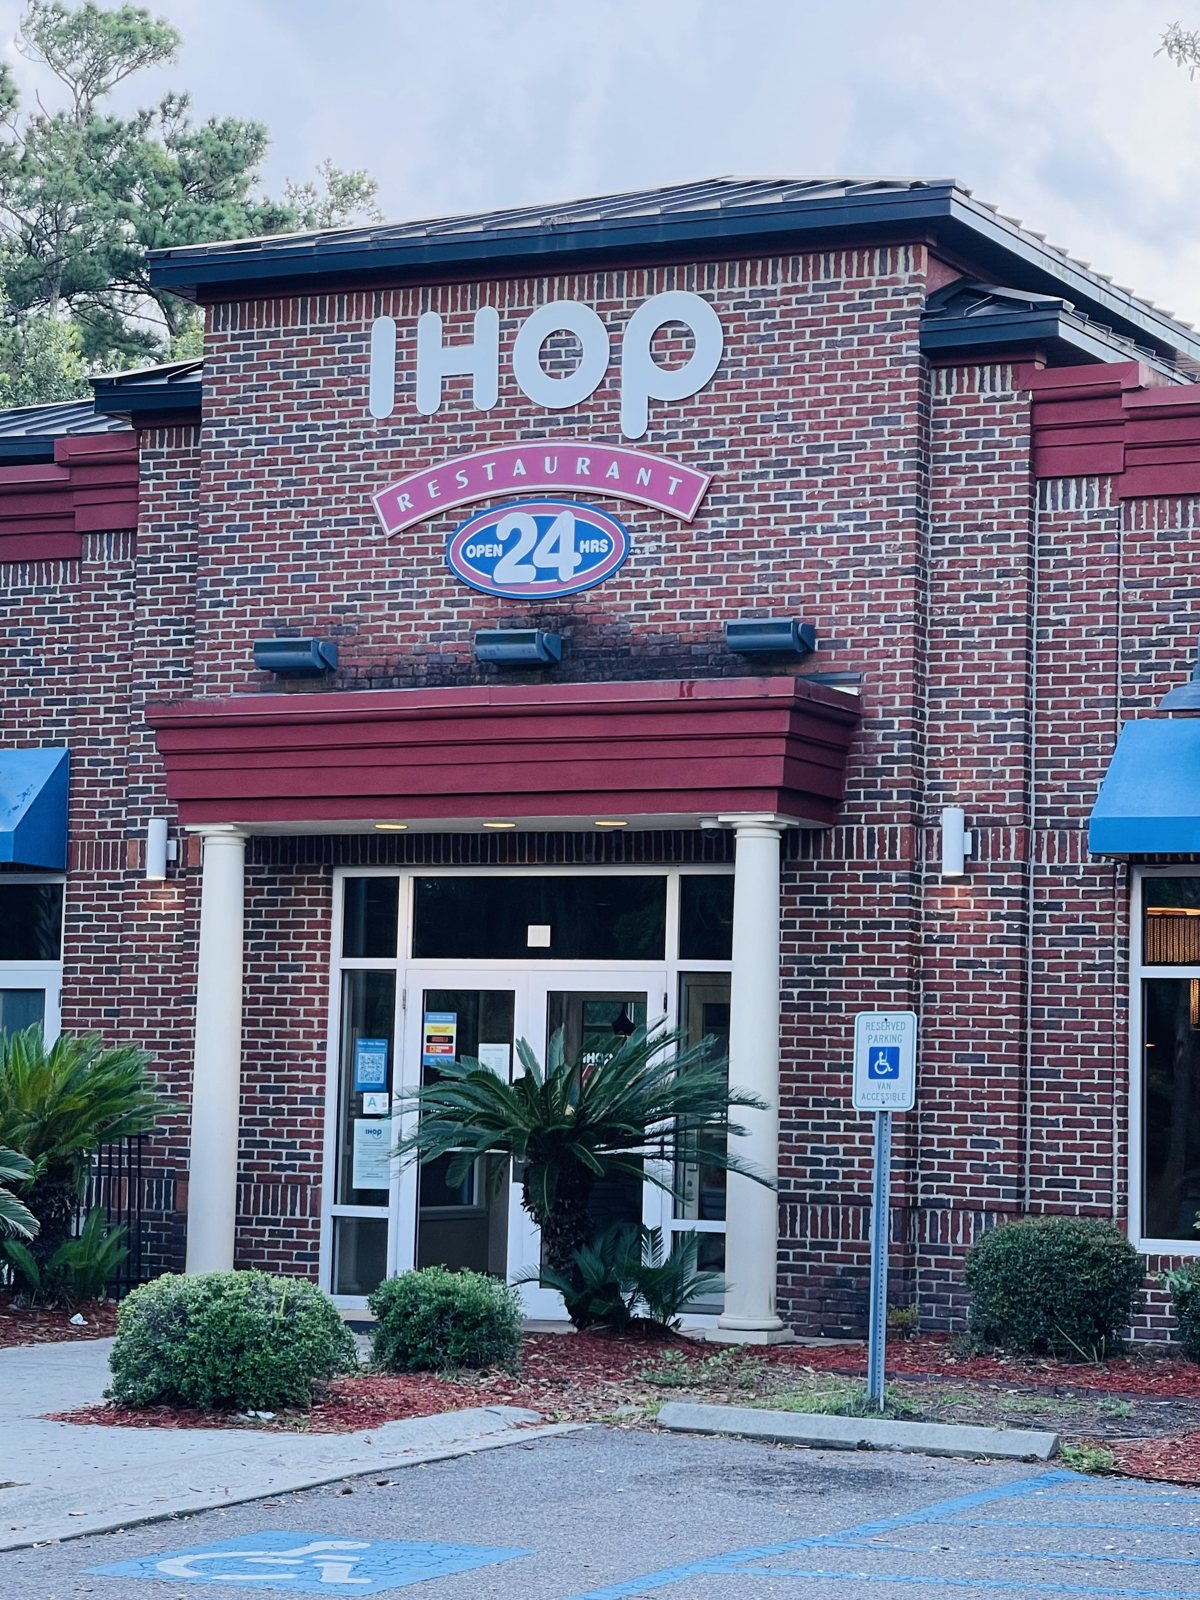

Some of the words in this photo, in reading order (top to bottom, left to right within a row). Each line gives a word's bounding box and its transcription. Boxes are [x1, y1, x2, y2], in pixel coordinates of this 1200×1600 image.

[397, 455, 683, 513] RESTAURANT
[466, 543, 503, 559] OPEN
[493, 510, 582, 585] 24
[579, 539, 609, 554] HRS
[865, 1021, 906, 1031] RESERVED
[868, 1034, 903, 1044] PARKING
[877, 1082, 891, 1090] VAN
[861, 1092, 906, 1101] ACCESSIBLE
[367, 1096, 377, 1108] A
